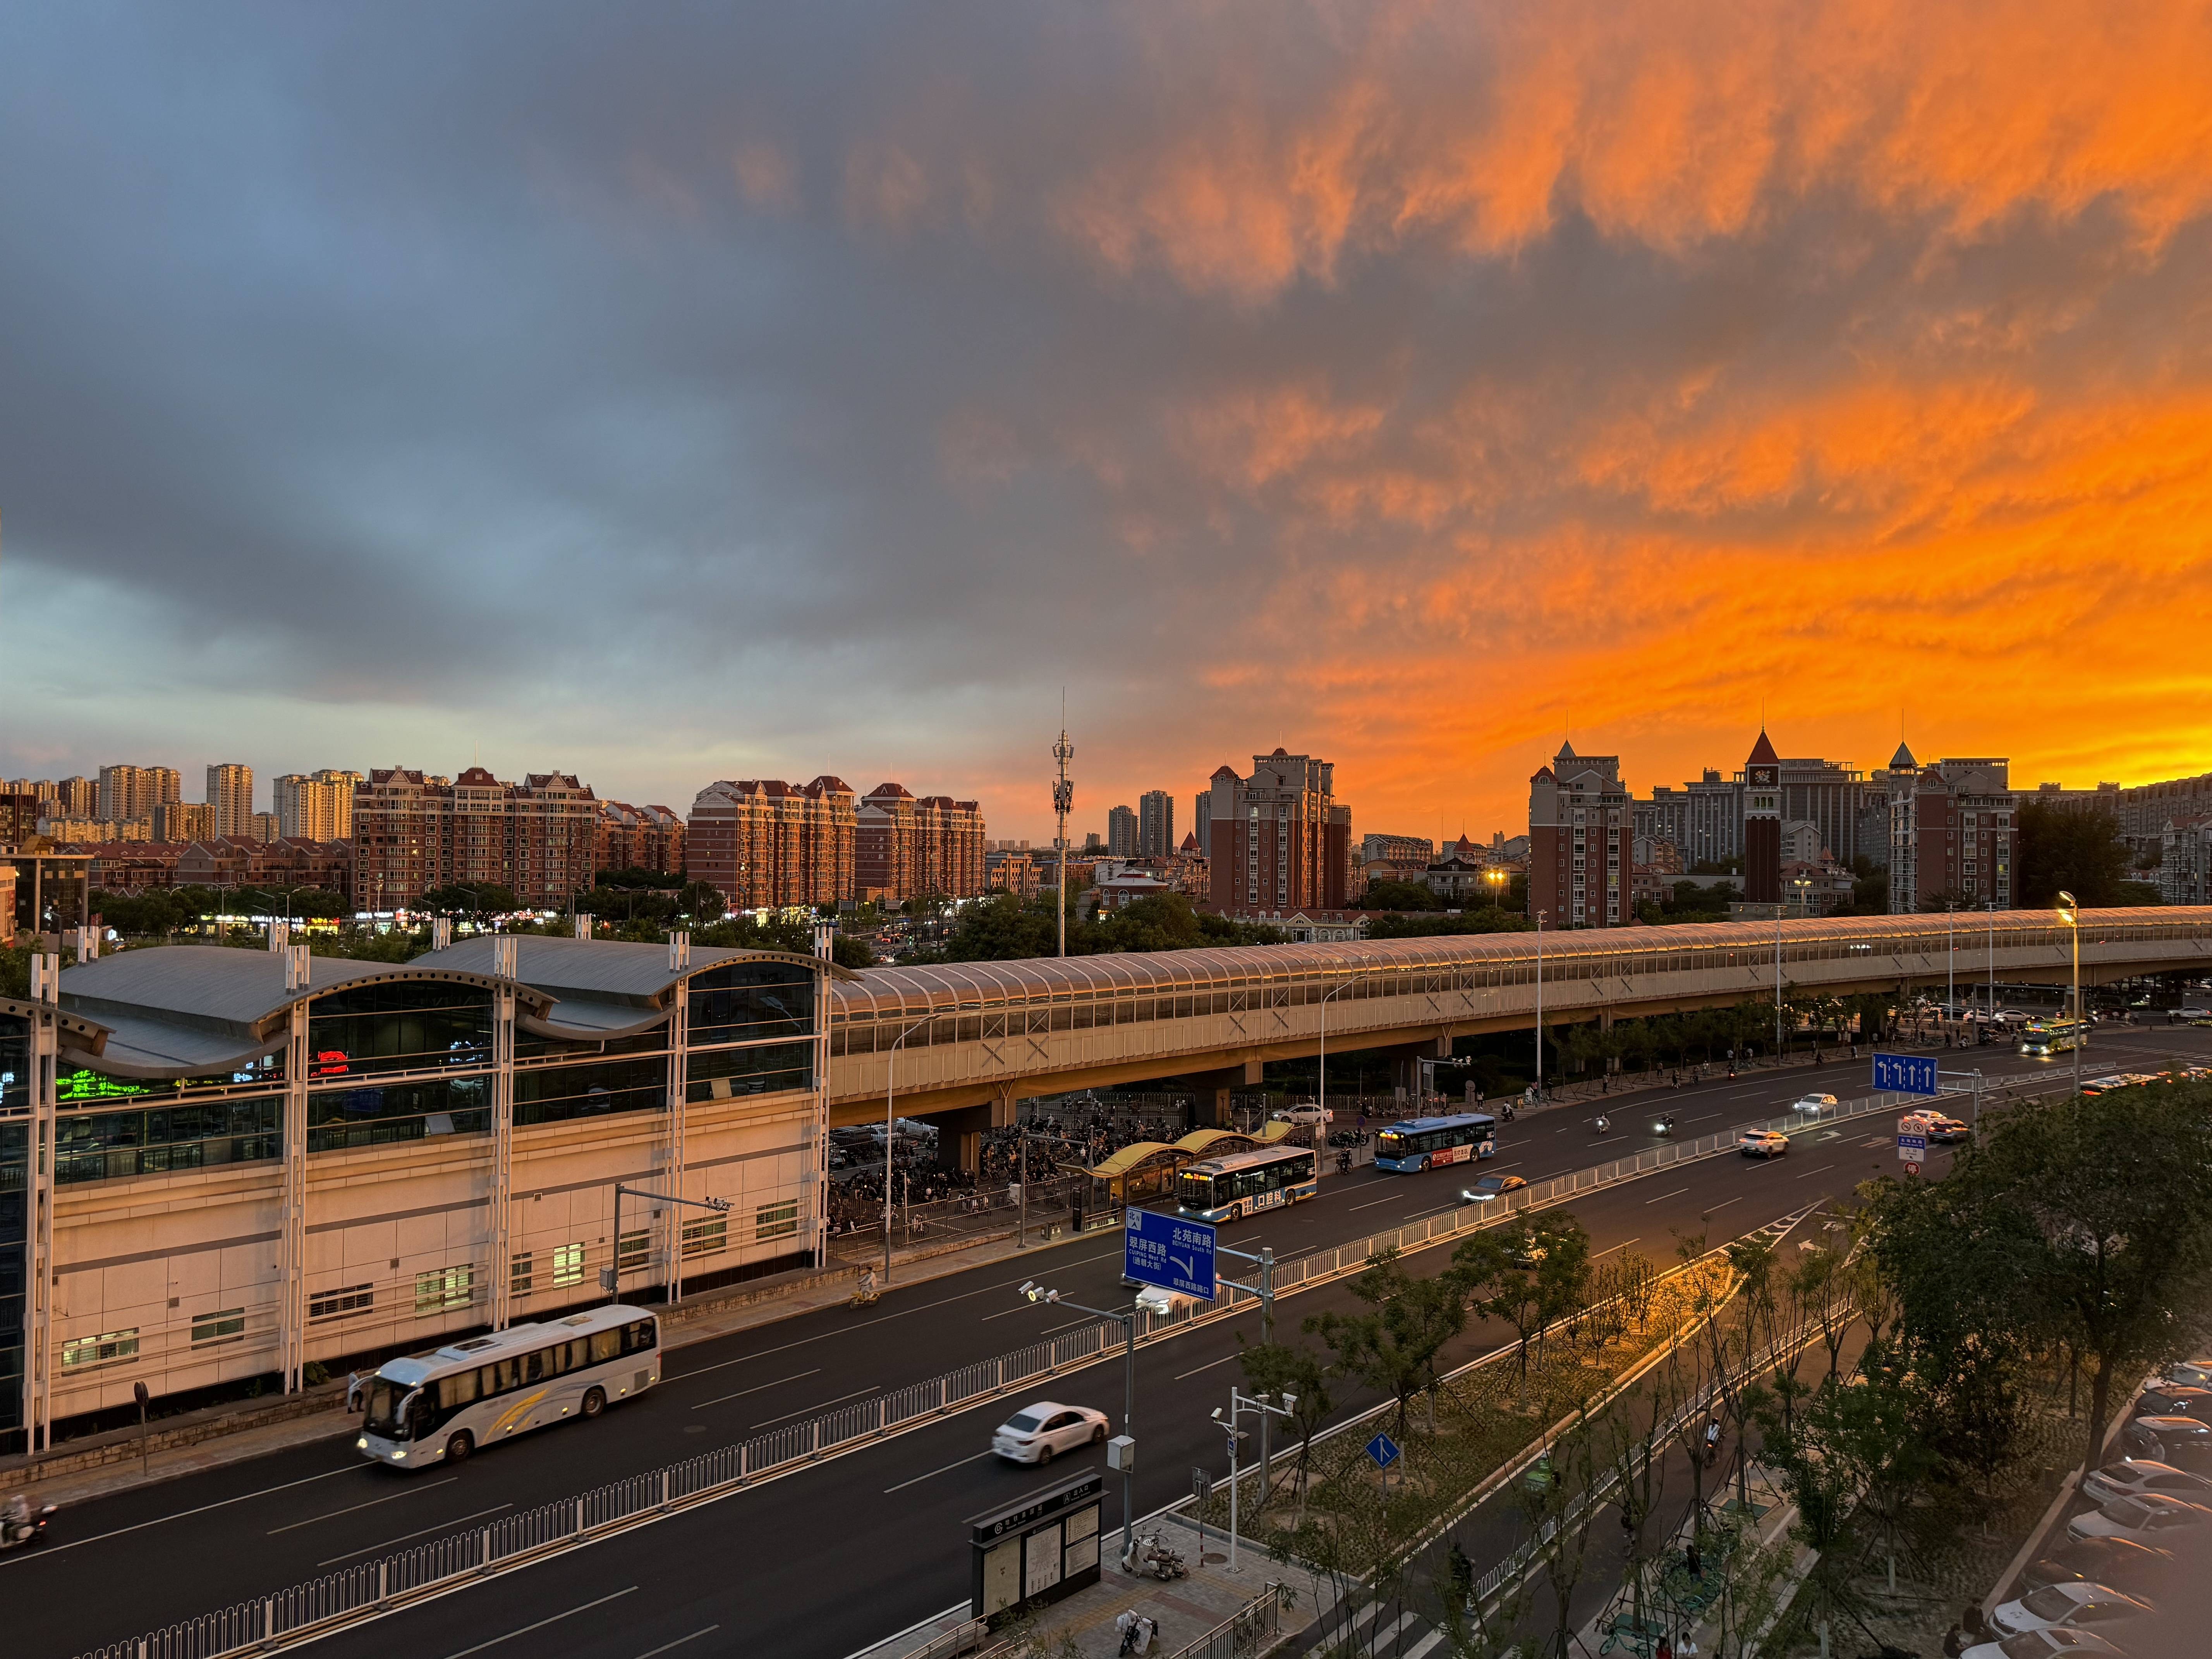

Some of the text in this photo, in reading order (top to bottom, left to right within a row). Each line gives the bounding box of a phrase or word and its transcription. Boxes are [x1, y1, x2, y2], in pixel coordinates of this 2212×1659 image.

[1258, 1190, 1281, 1207] 口腔科
[1129, 1211, 1135, 1220] 北
[1172, 1240, 1190, 1249] BEIYUAN
[1173, 1227, 1211, 1248] 北苑南路
[1129, 1236, 1166, 1257] 翠屏西路
[1129, 1249, 1147, 1258] CUIPING
[1133, 1256, 1161, 1271] (通朝大街)
[1173, 1278, 1209, 1294] 翠屏西路路口
